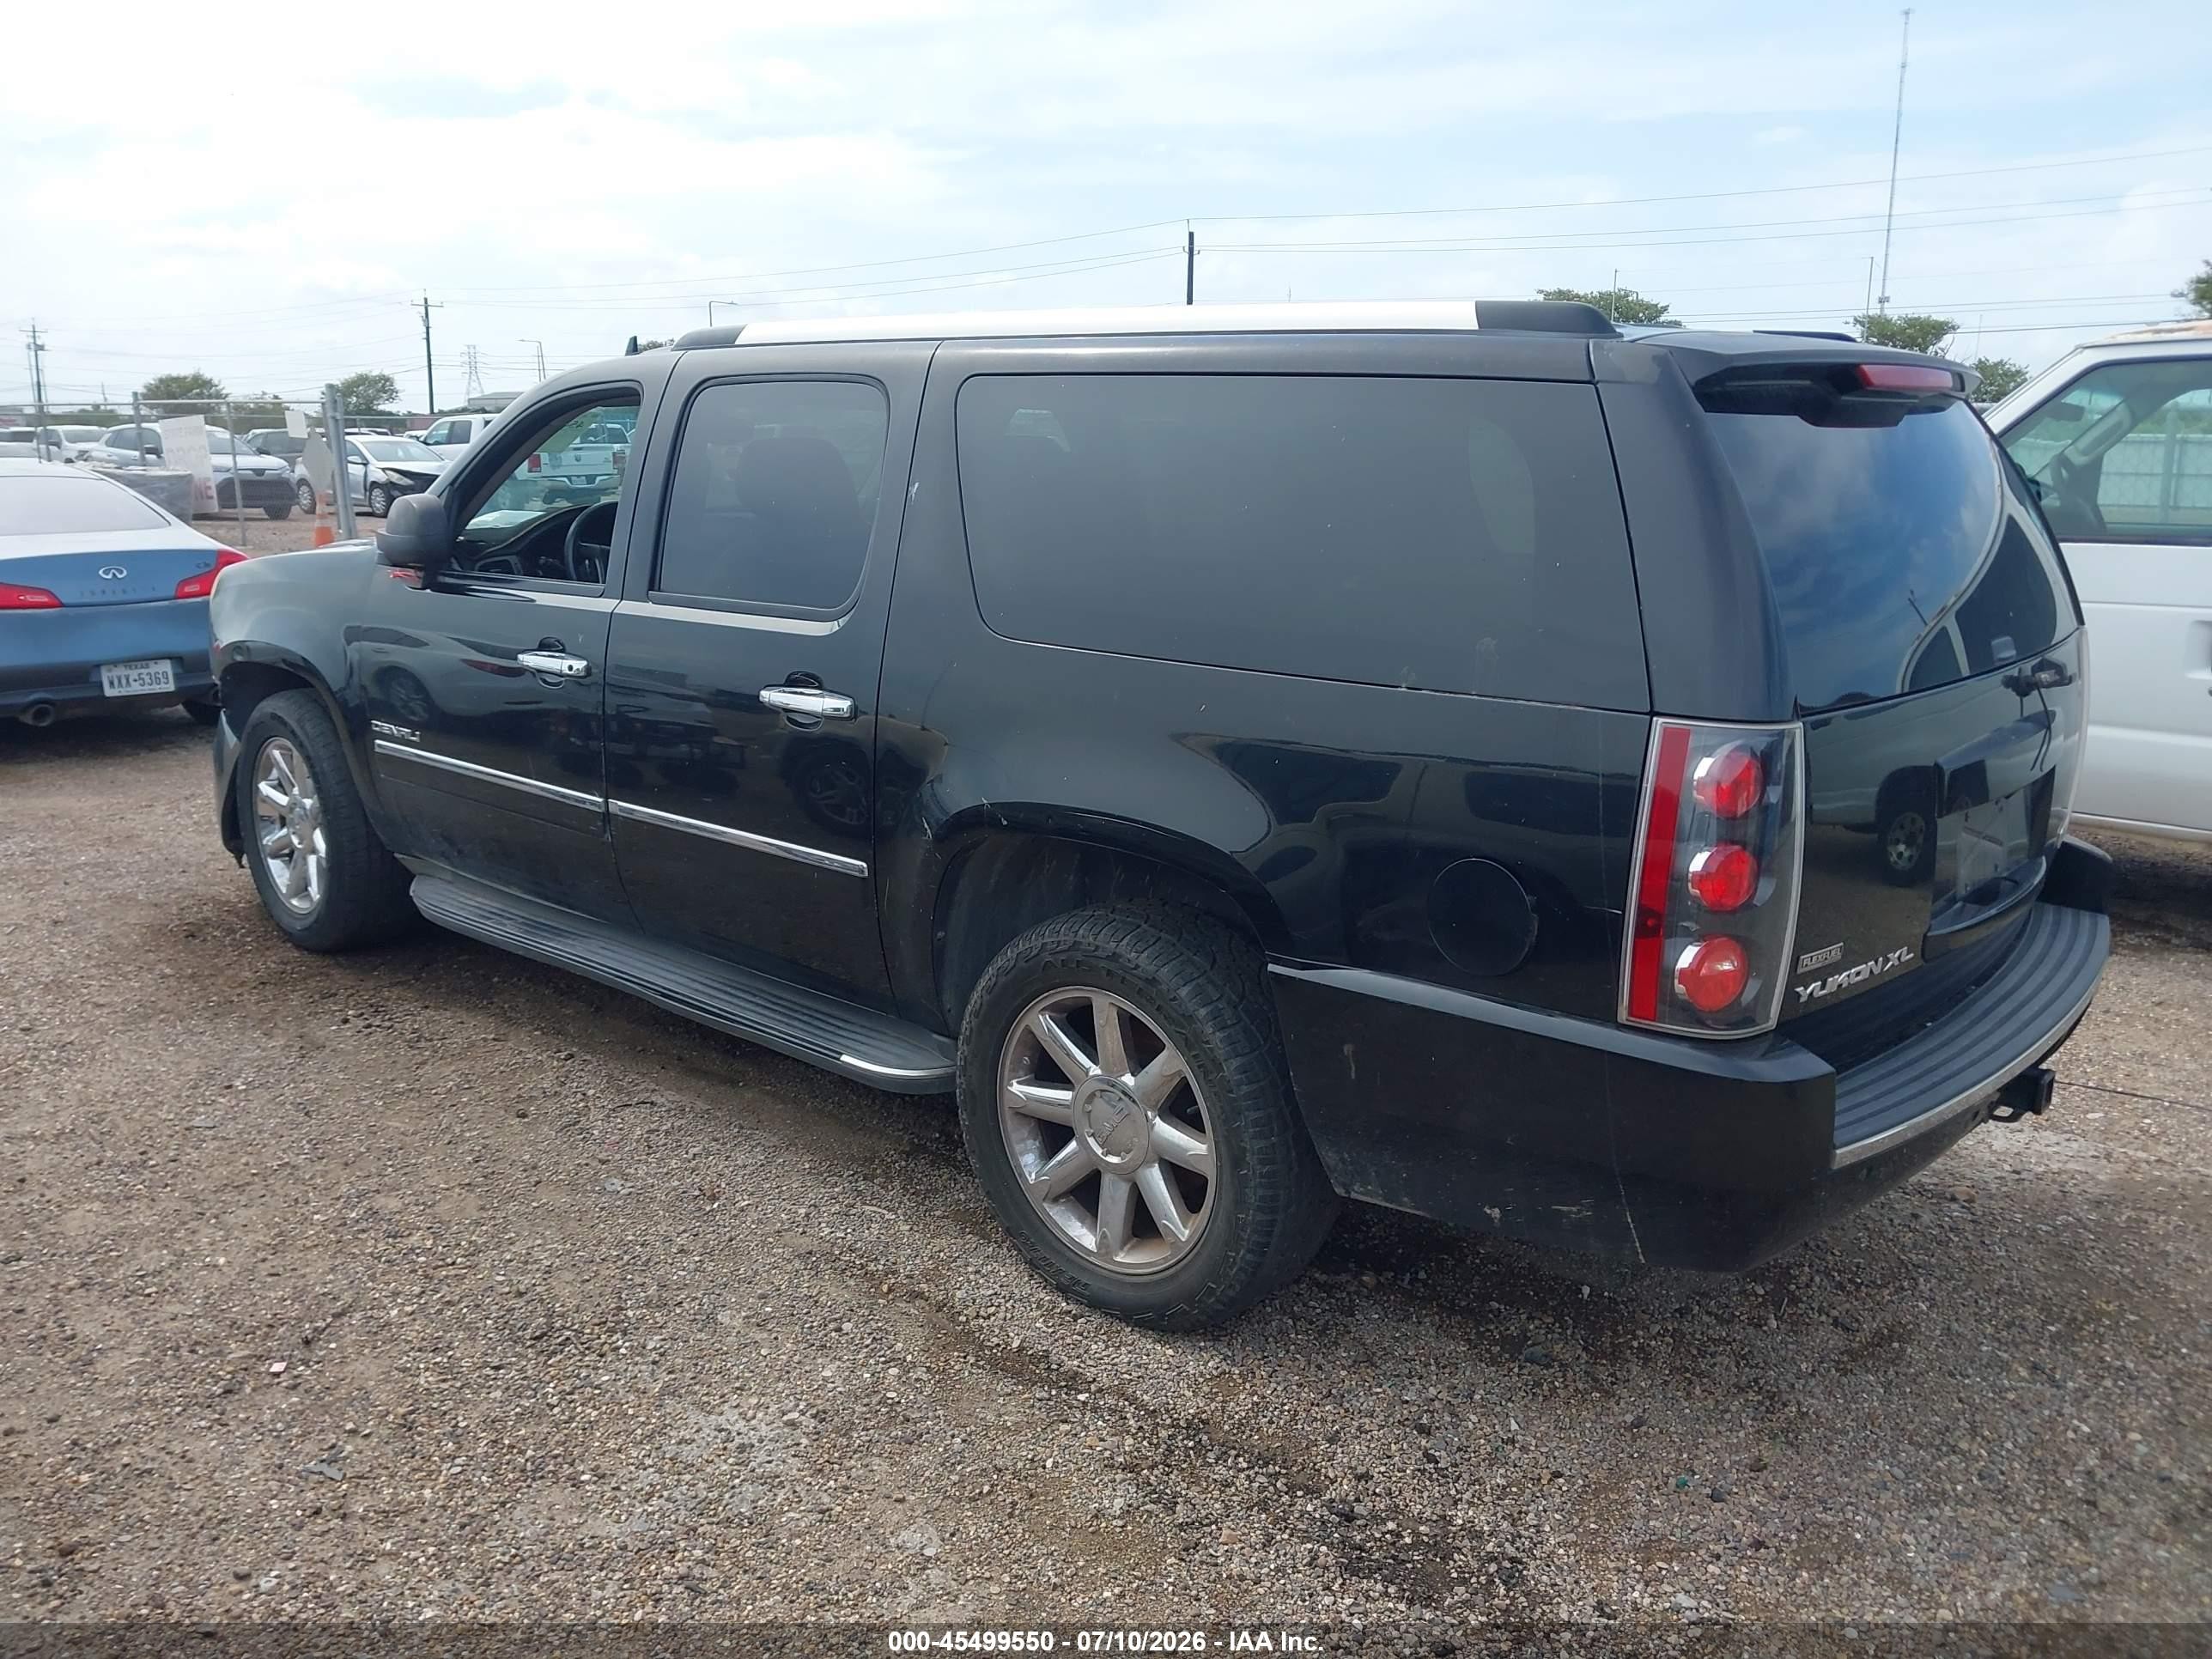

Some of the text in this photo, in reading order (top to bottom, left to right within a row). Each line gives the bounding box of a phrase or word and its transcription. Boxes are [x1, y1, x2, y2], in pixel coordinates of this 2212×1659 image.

[123, 662, 150, 671] TEXAS
[1802, 947, 1842, 968] FLEXFUEL
[1794, 945, 1915, 1003] YUKON XL
